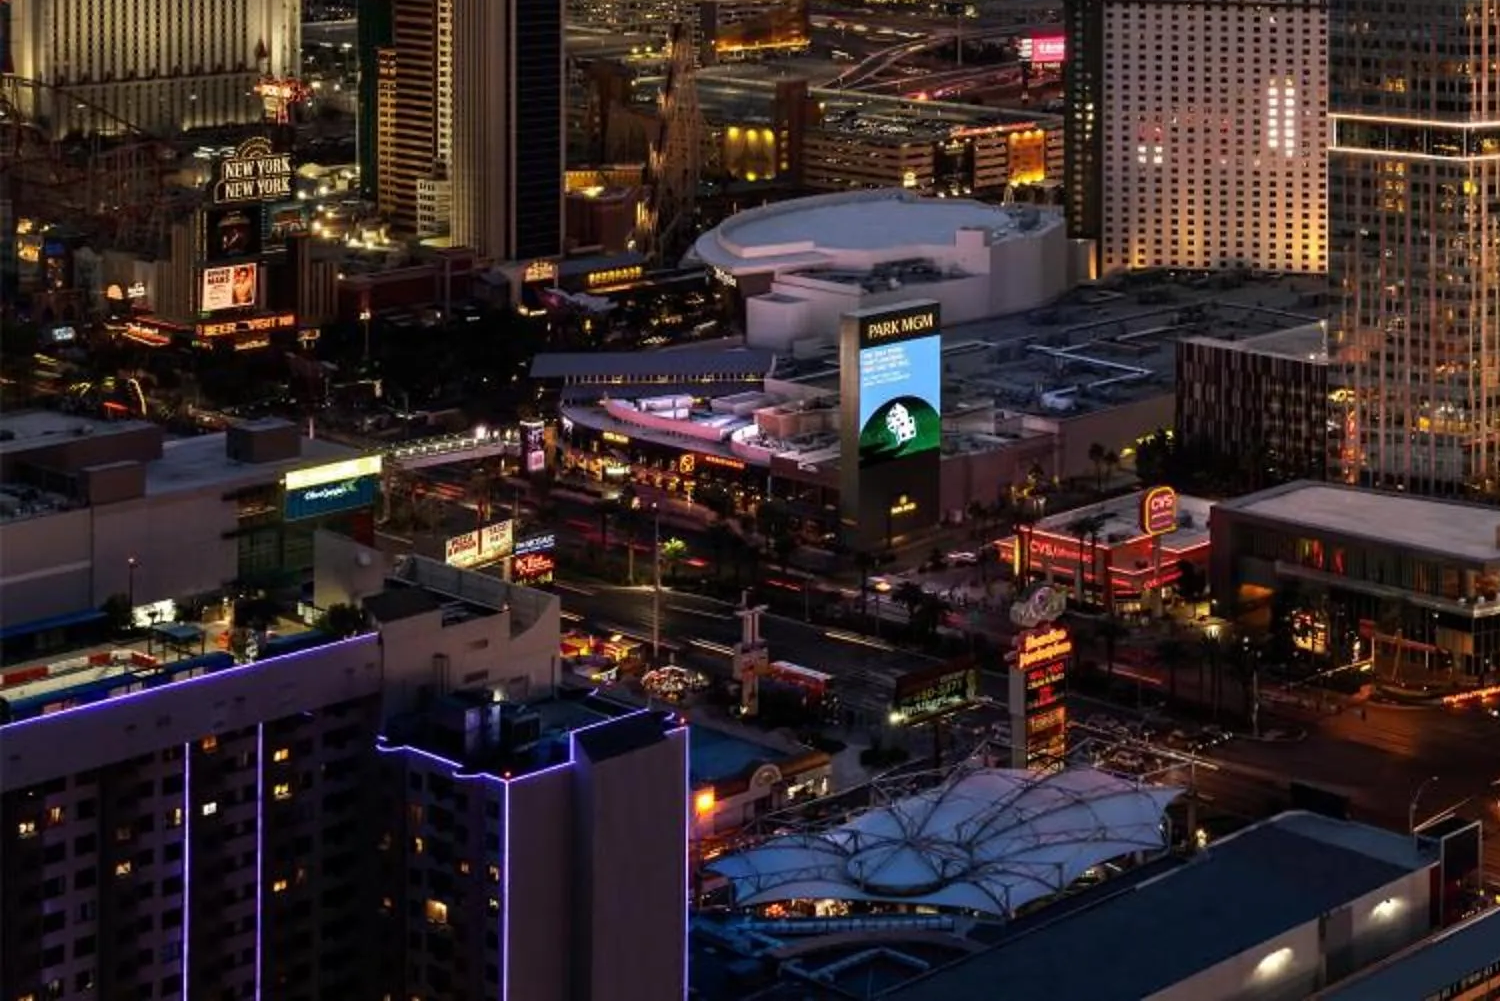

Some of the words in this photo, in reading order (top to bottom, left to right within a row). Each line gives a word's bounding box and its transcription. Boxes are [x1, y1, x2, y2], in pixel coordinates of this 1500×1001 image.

[225, 159, 256, 178] NEW
[258, 157, 291, 175] YORK
[225, 179, 256, 198] NEW
[258, 177, 291, 195] YORK
[868, 320, 899, 340] PARK
[901, 312, 934, 332] MGM
[1151, 495, 1174, 510] CVS
